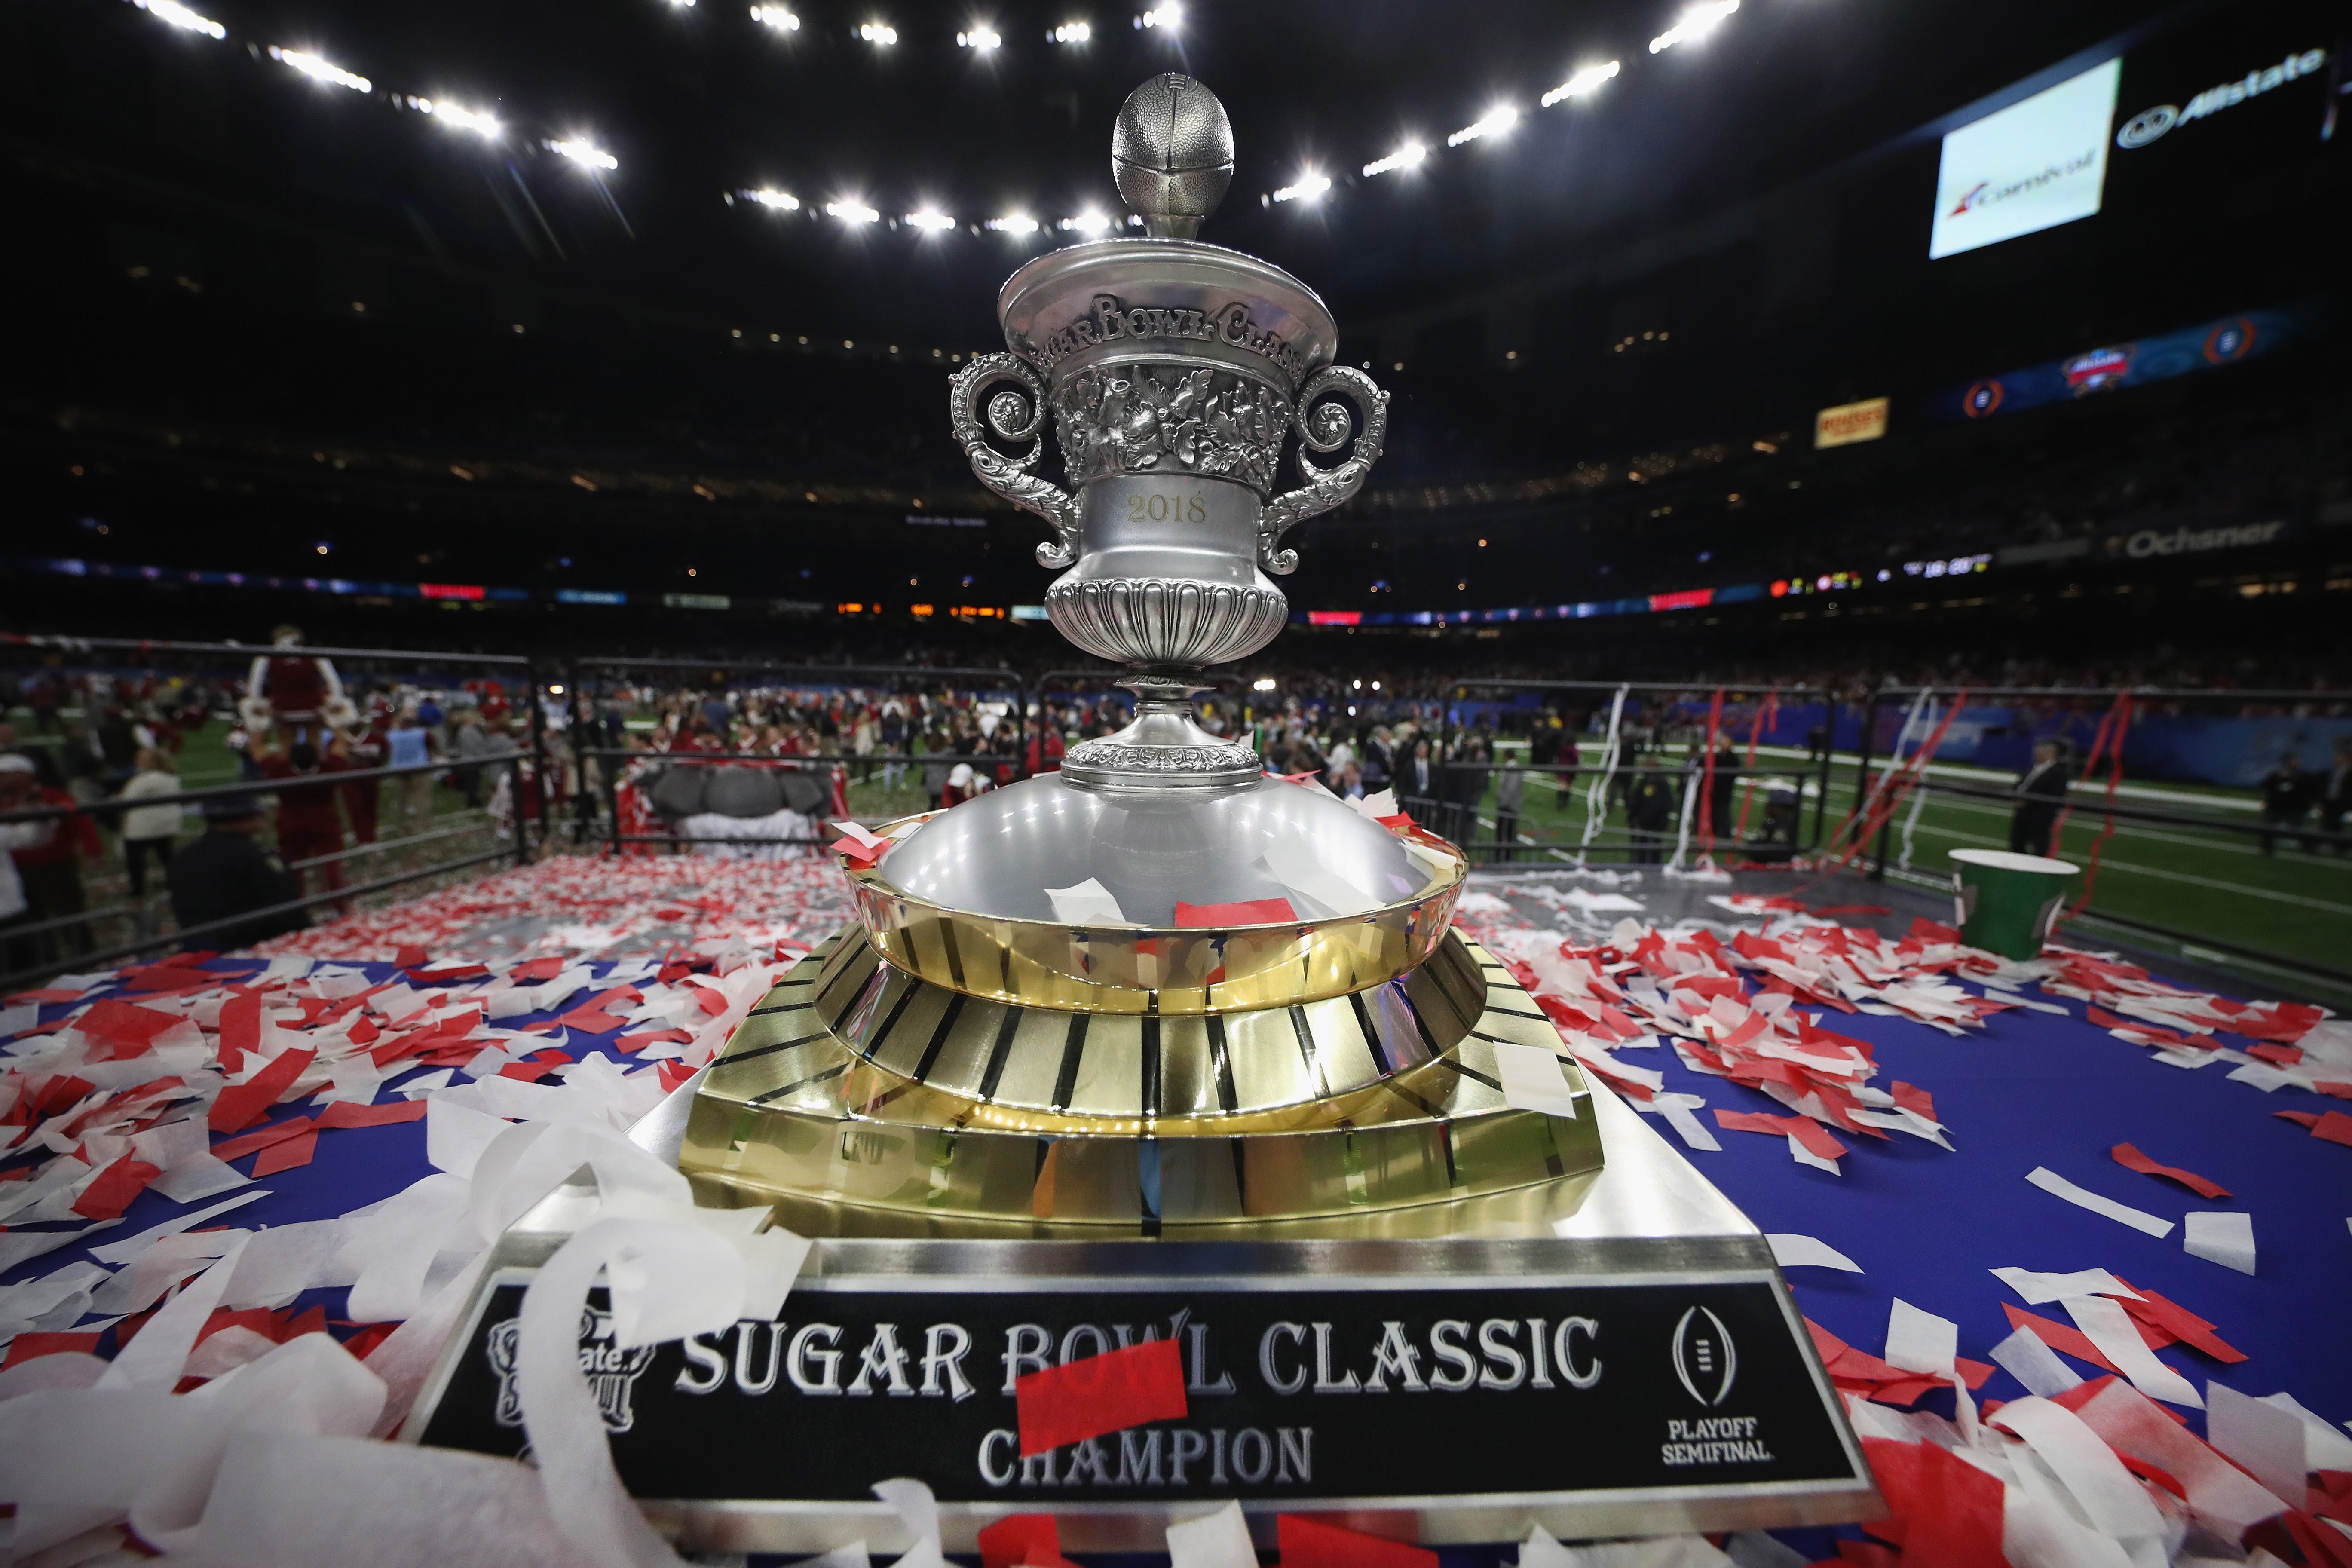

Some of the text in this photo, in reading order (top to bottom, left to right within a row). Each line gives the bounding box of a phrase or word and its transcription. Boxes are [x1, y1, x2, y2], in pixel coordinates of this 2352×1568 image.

[1127, 494, 1207, 523] 2018
[2127, 521, 2286, 559] Ochsner
[674, 1320, 976, 1402] SUGAR
[1259, 1315, 1602, 1395] CLASSIC
[1667, 1416, 1758, 1440] PLAYOFF
[977, 1426, 1314, 1488] CHAMPION
[1661, 1440, 1771, 1465] SEMIFINAL
